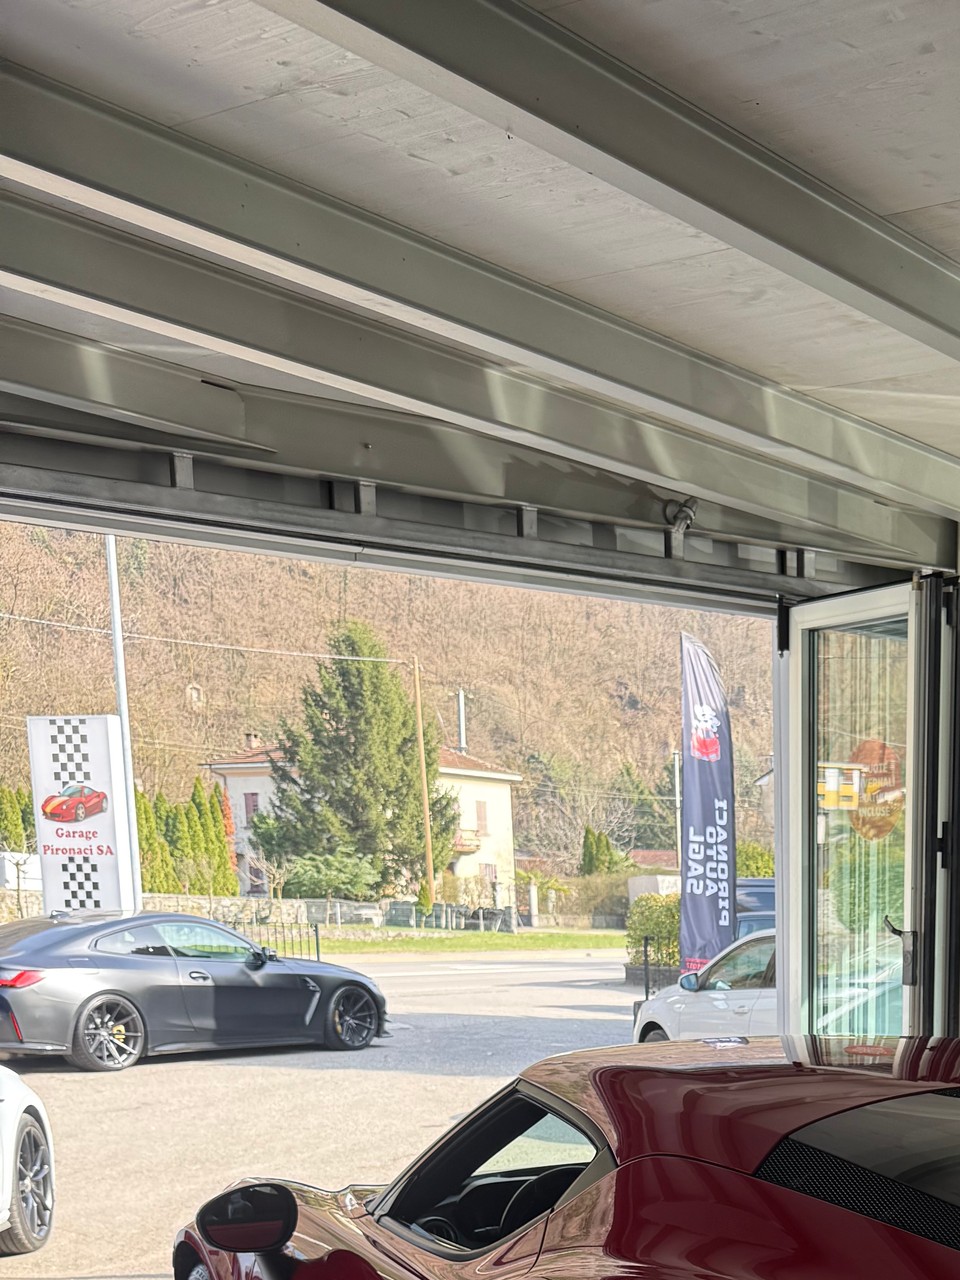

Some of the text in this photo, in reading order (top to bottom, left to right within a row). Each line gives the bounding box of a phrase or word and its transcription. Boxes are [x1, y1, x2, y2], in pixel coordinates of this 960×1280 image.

[55, 827, 98, 841] Garage
[42, 844, 114, 856] Pironaci SA
